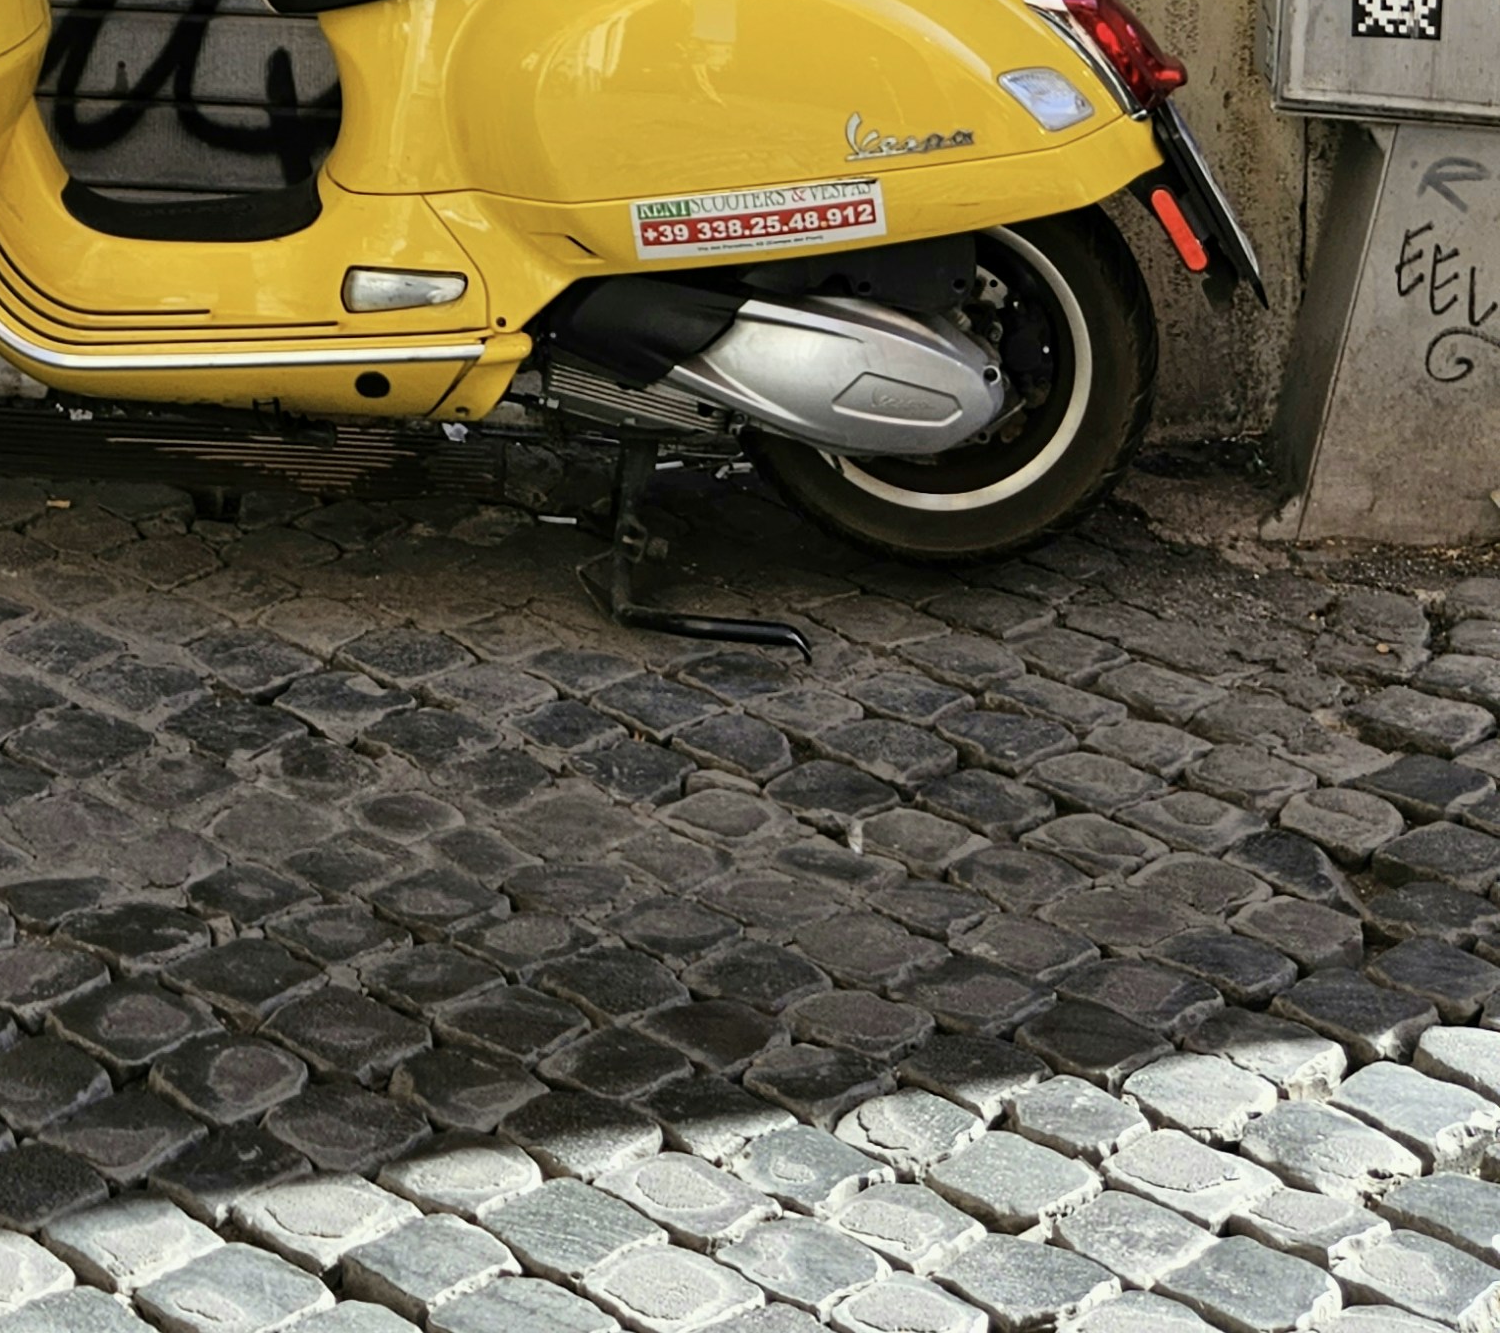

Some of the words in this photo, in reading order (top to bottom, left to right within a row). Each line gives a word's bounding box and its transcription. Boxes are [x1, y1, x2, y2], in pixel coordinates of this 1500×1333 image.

[689, 189, 786, 214] SCOOTERS
[643, 223, 690, 243] +39
[696, 203, 875, 240] 338.25.48.912
